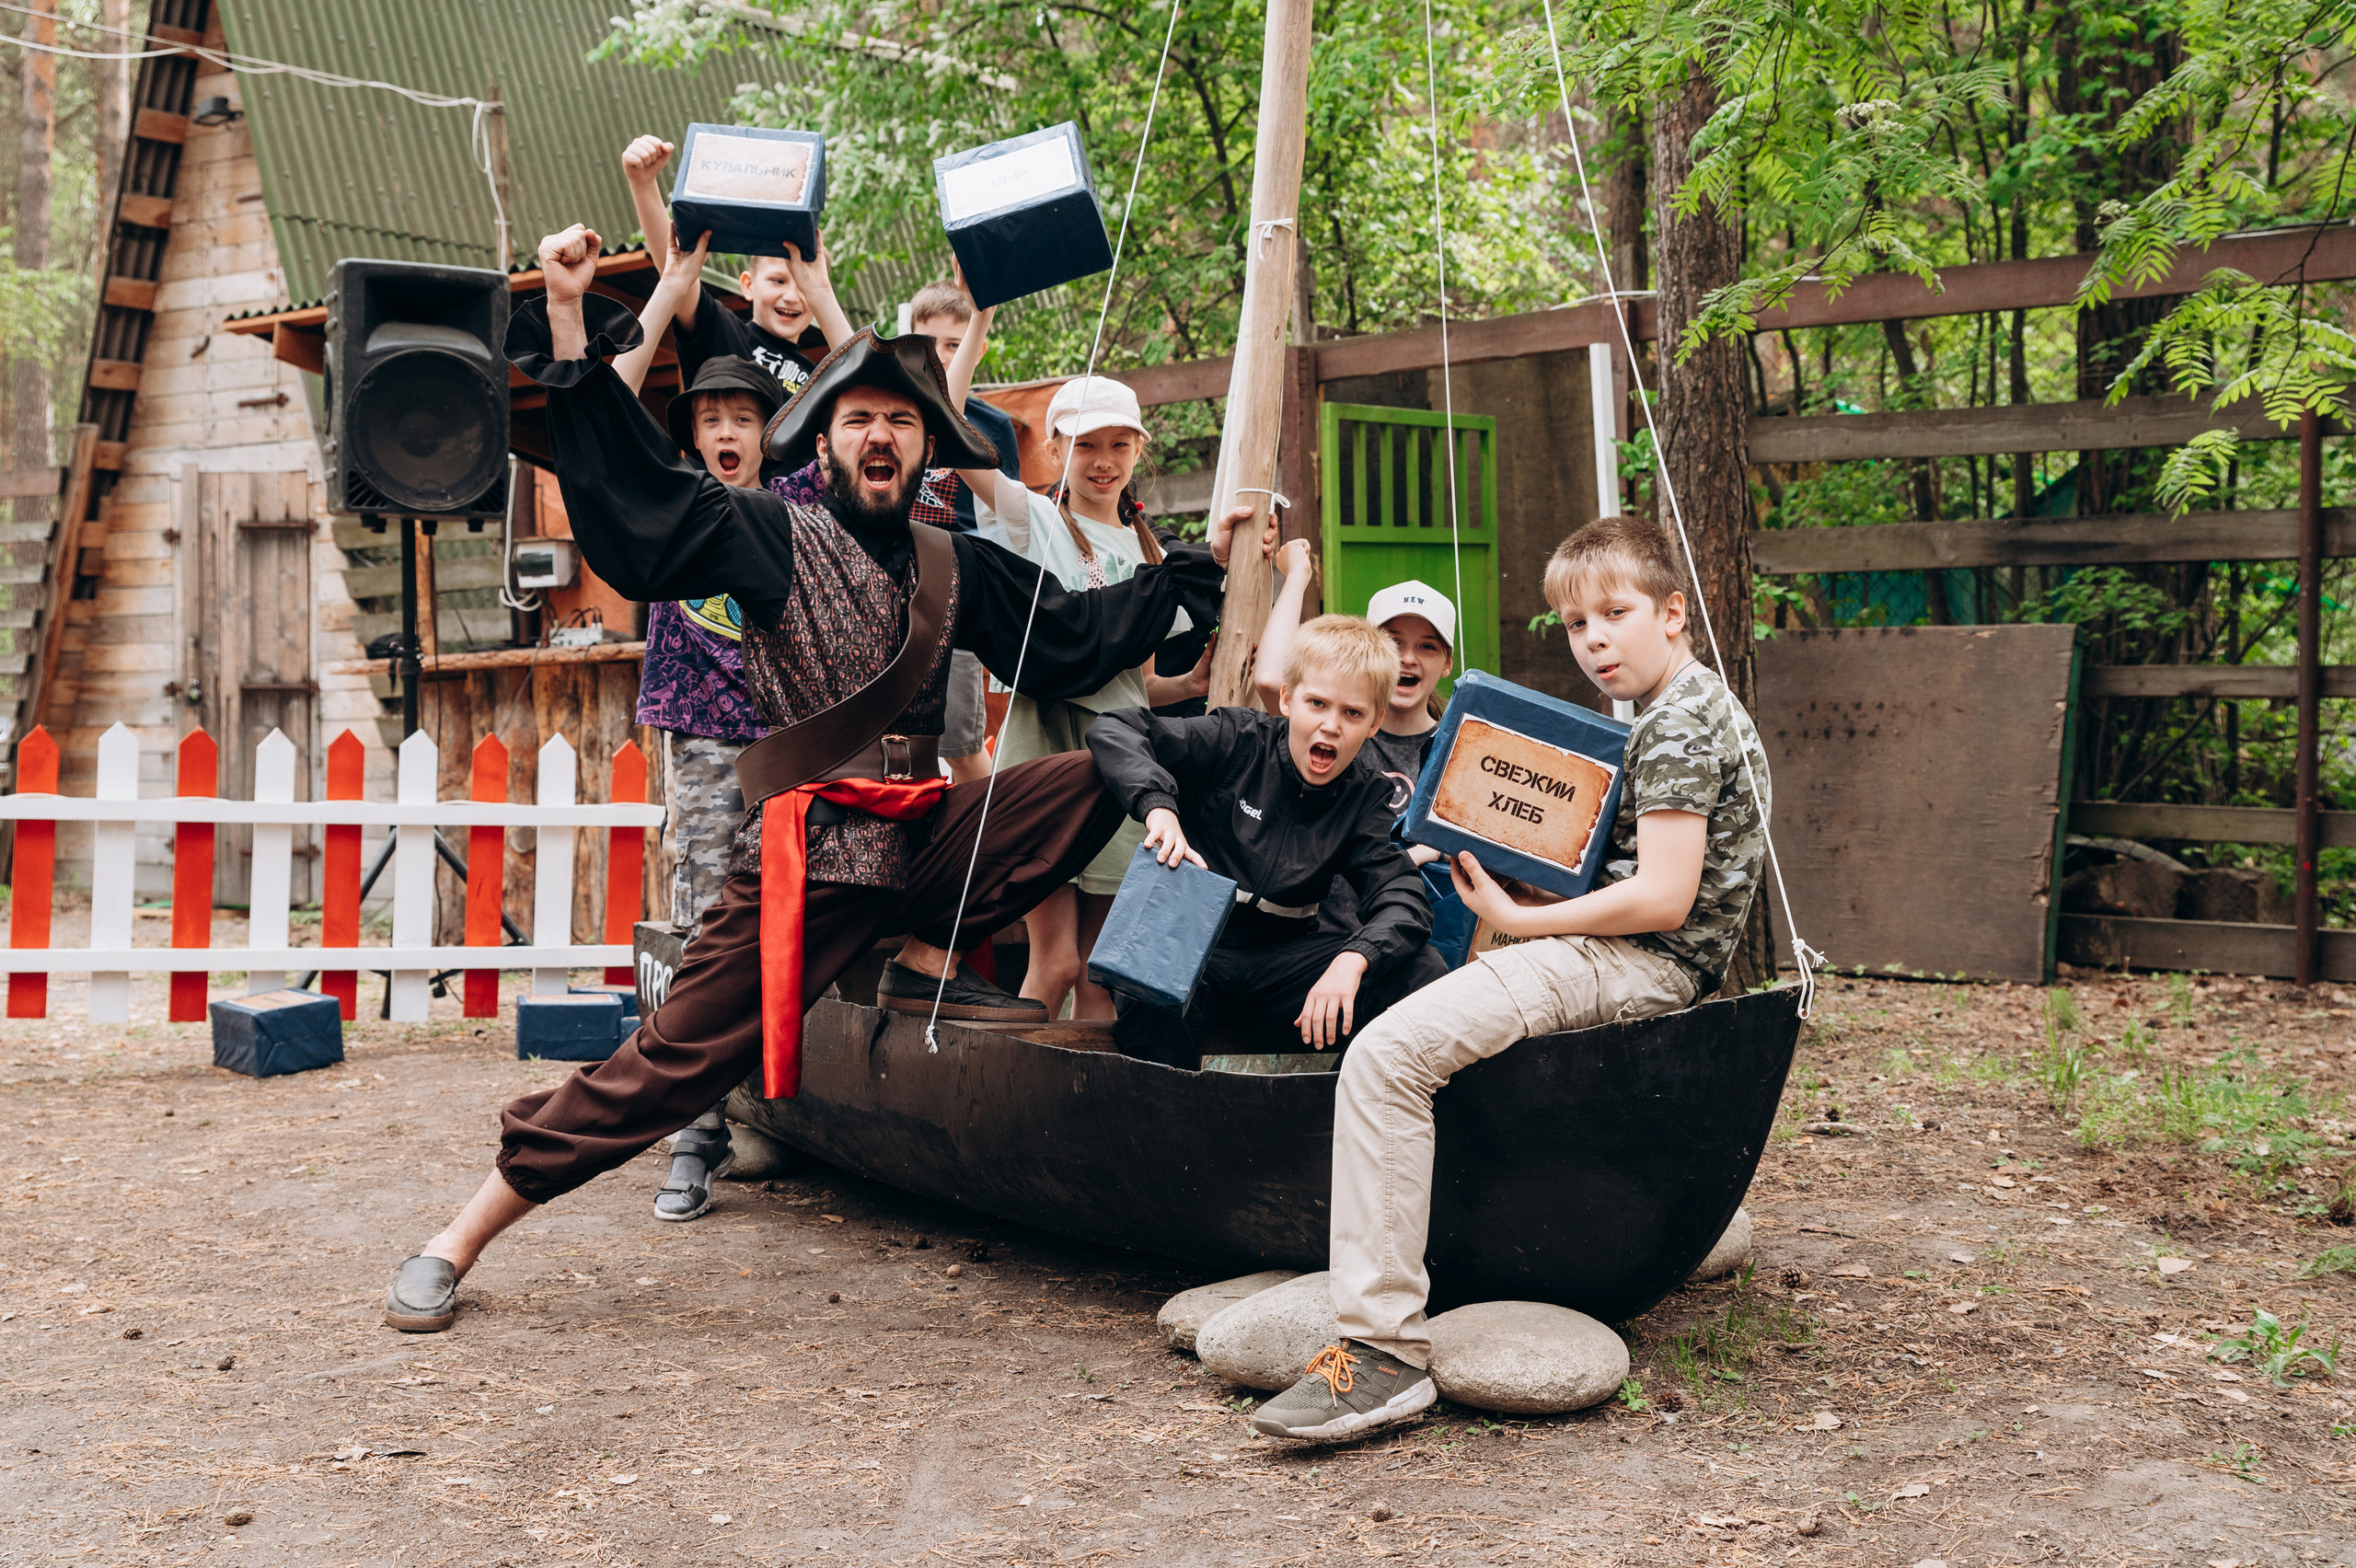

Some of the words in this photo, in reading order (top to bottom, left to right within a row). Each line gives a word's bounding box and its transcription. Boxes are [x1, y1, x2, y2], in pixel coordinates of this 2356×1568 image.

[700, 159, 797, 178] КУПАЛЬНИК
[991, 169, 1028, 186] СЫР
[1403, 596, 1425, 605] NEW
[1480, 755, 1576, 802] СВЕЖИЙ
[1487, 790, 1545, 824] ХЛЕБ
[640, 951, 683, 1011] ПРО
